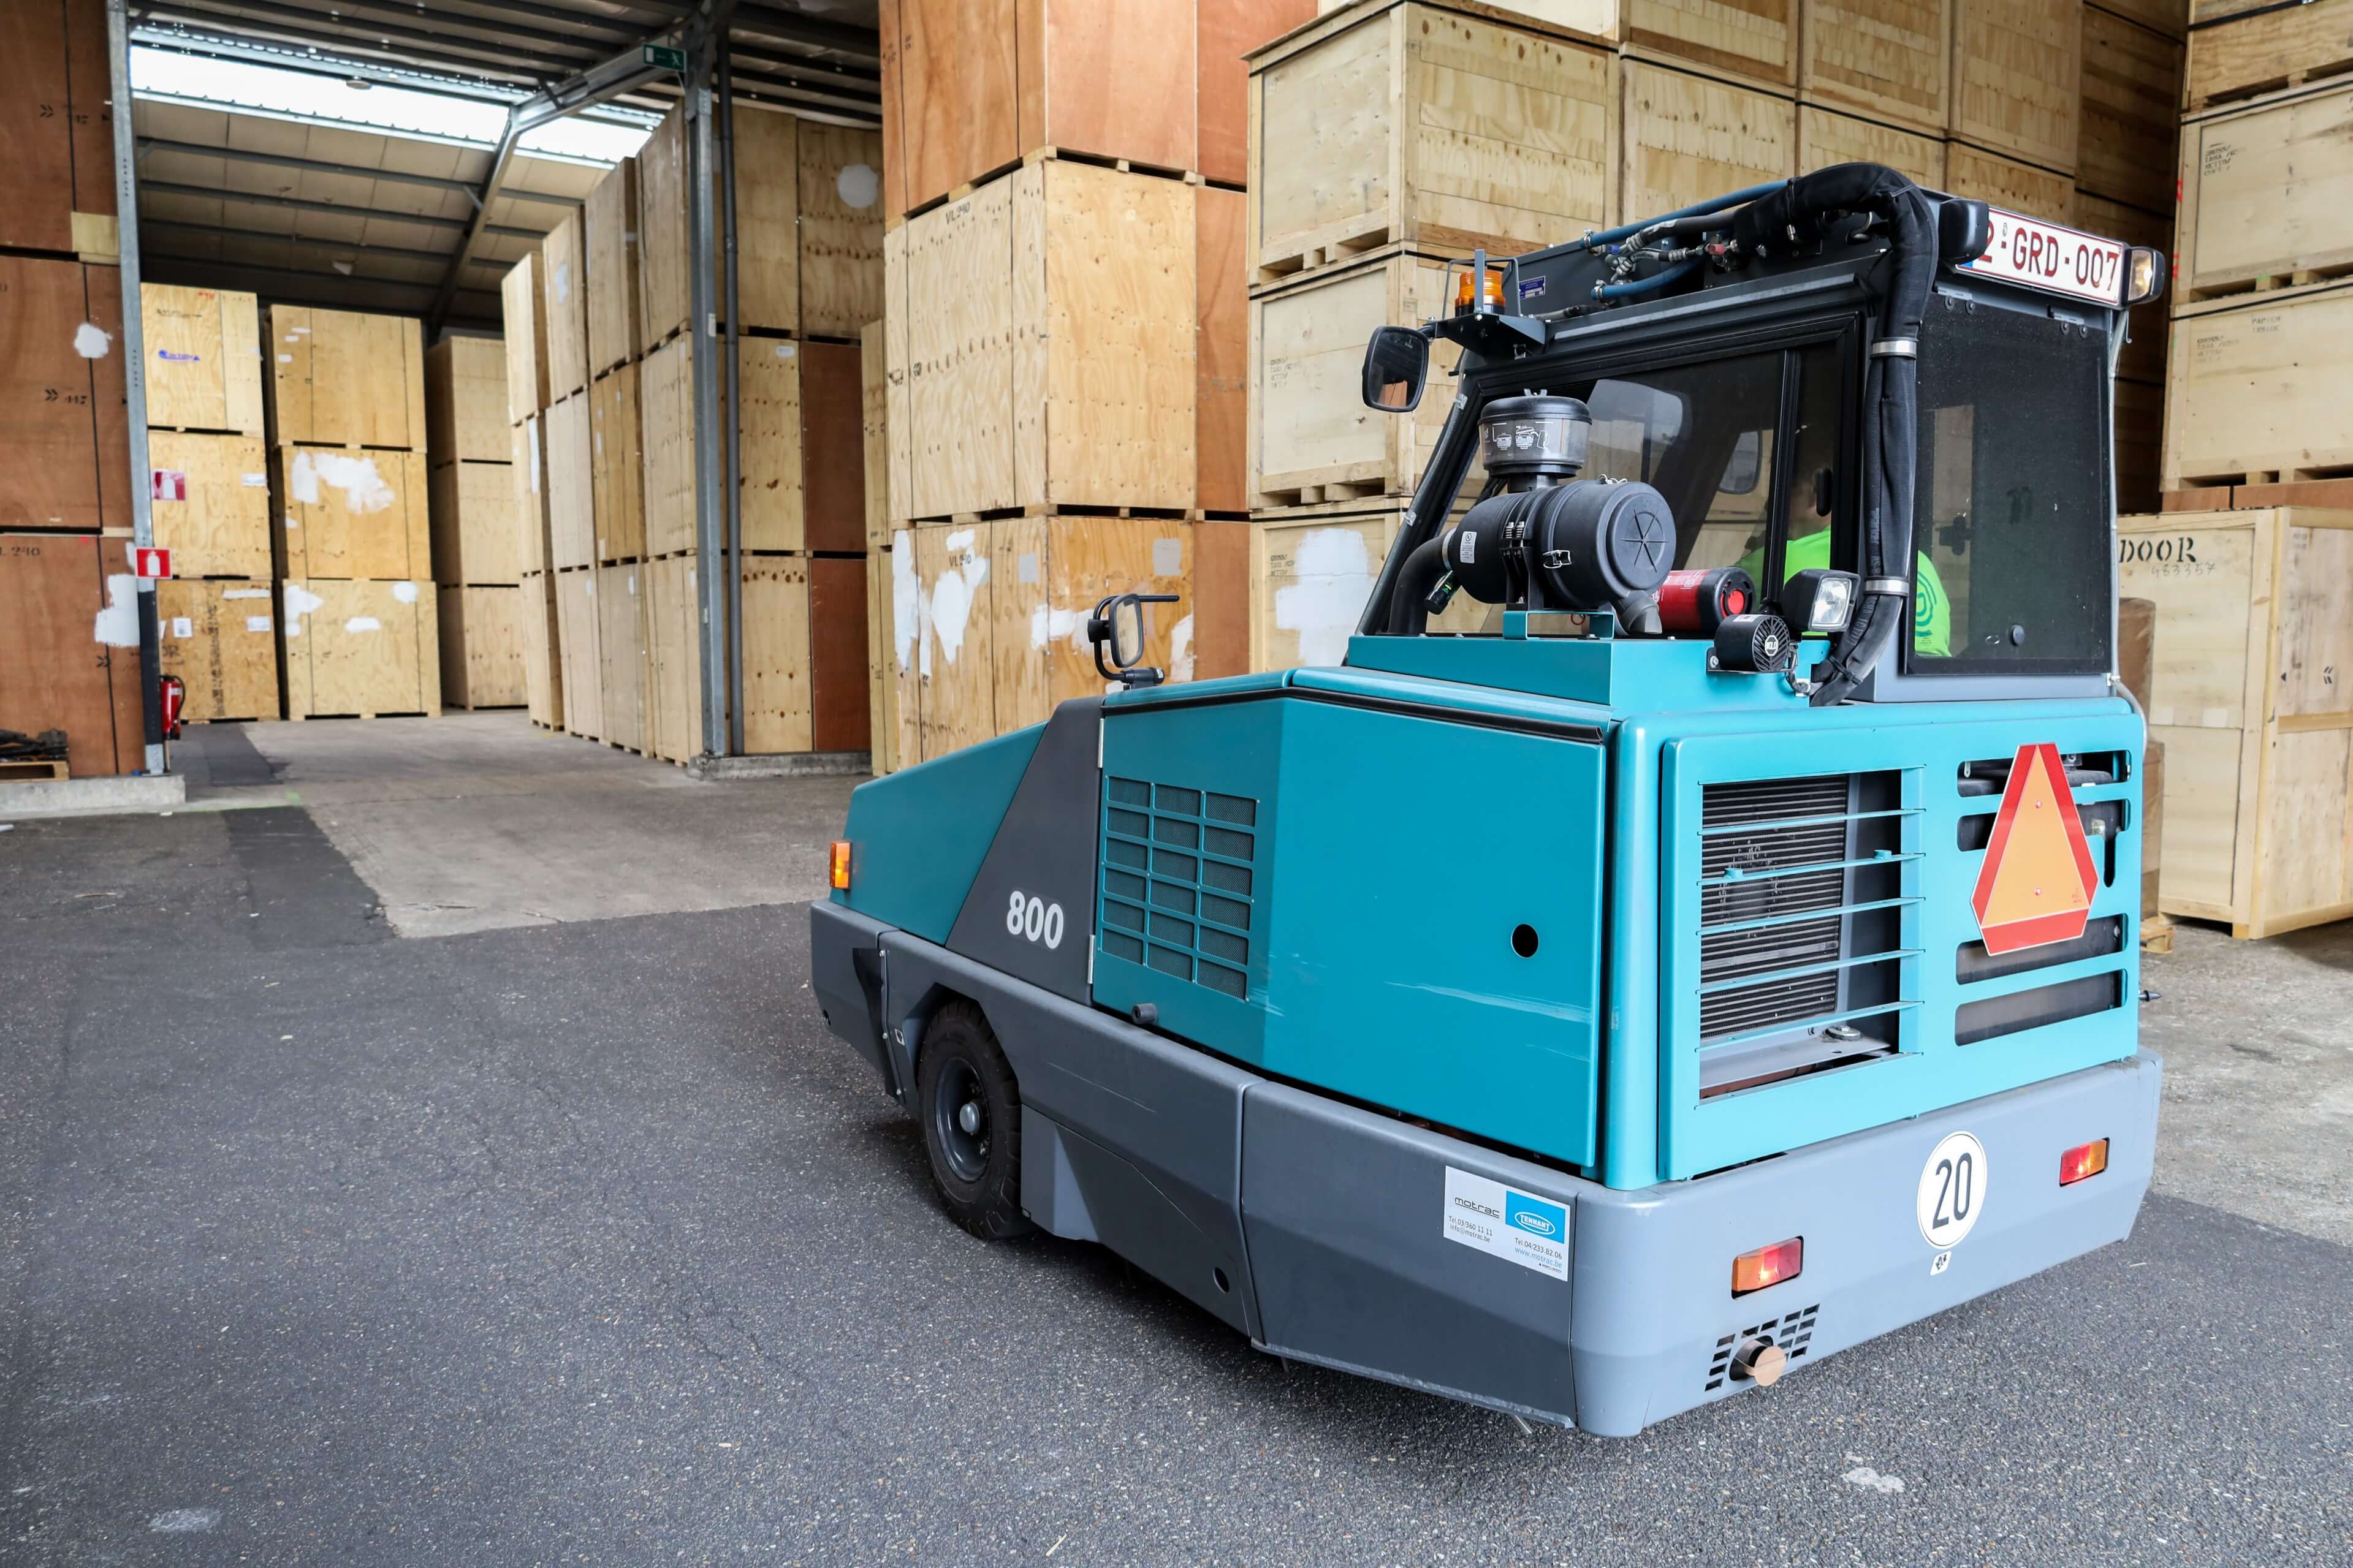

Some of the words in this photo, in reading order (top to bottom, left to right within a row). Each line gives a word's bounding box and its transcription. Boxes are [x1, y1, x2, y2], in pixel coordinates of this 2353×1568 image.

[2118, 537, 2197, 563] DOOR
[1007, 890, 1064, 949] 800
[1932, 1153, 1972, 1230] 20
[1454, 1197, 1500, 1218] motrac
[1520, 1214, 1550, 1232] TENNANT
